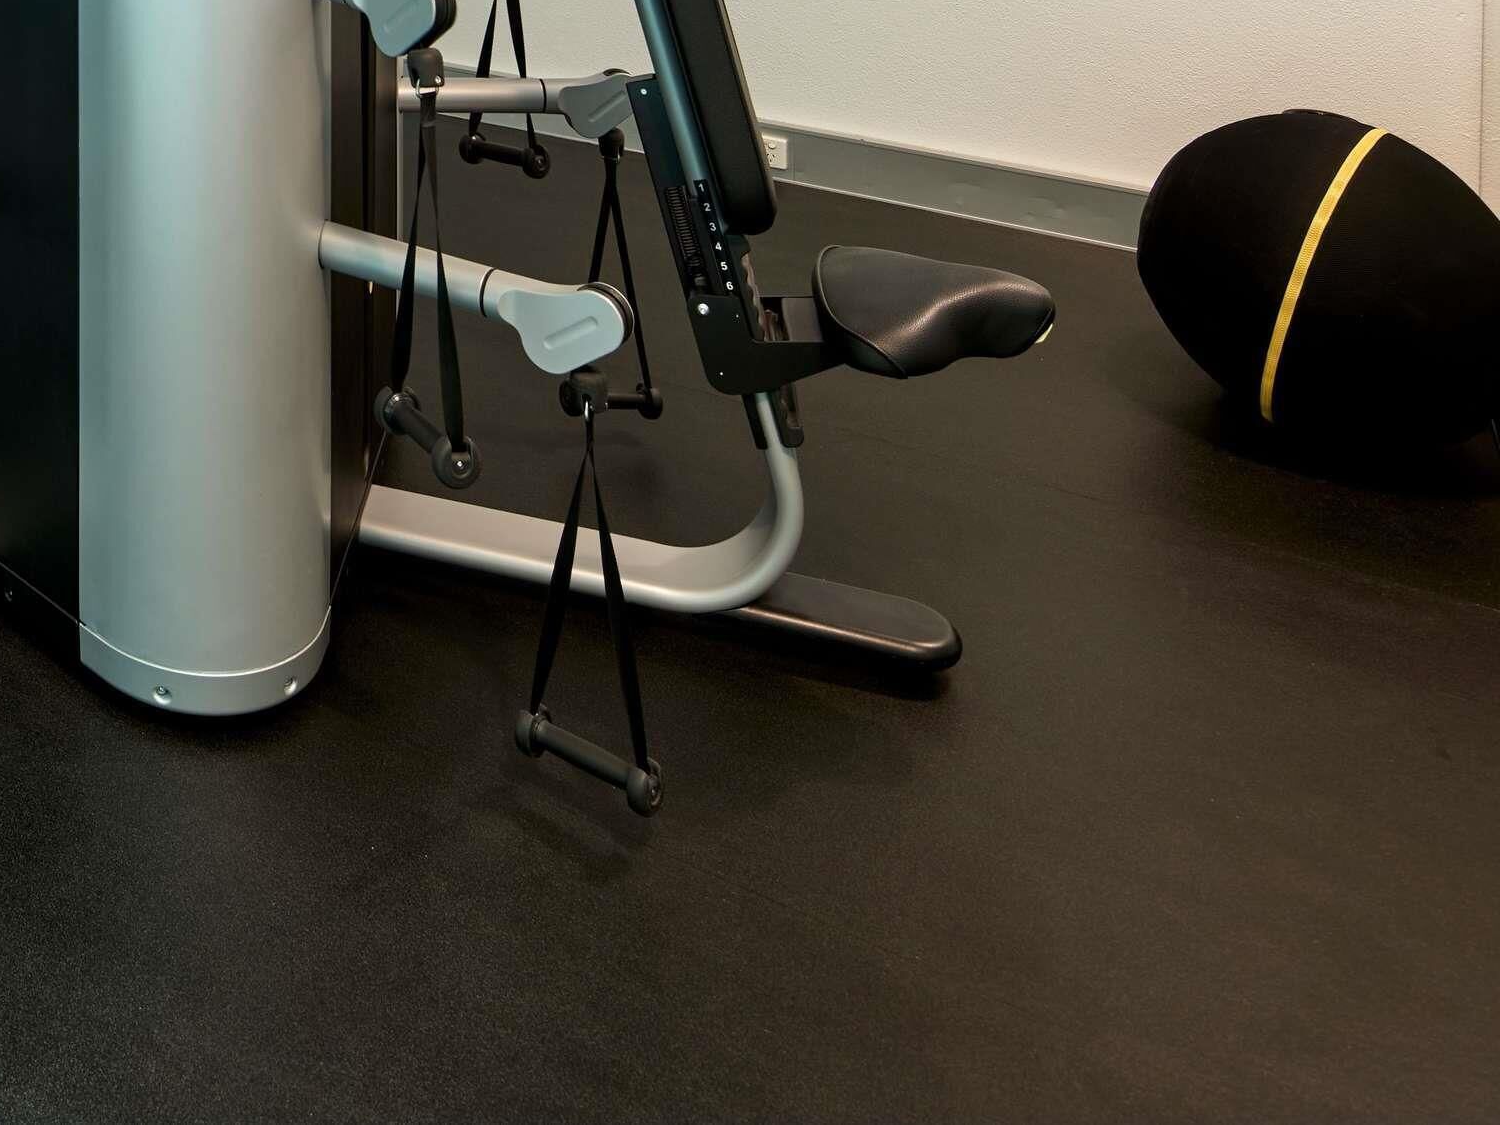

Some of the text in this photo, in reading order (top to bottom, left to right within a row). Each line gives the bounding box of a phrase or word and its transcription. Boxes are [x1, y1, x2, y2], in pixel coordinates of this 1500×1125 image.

[698, 183, 705, 192] 1
[703, 203, 711, 212] 2
[709, 222, 716, 231] 3
[715, 242, 722, 251] 4
[720, 261, 727, 270] 5
[726, 281, 733, 290] 6
